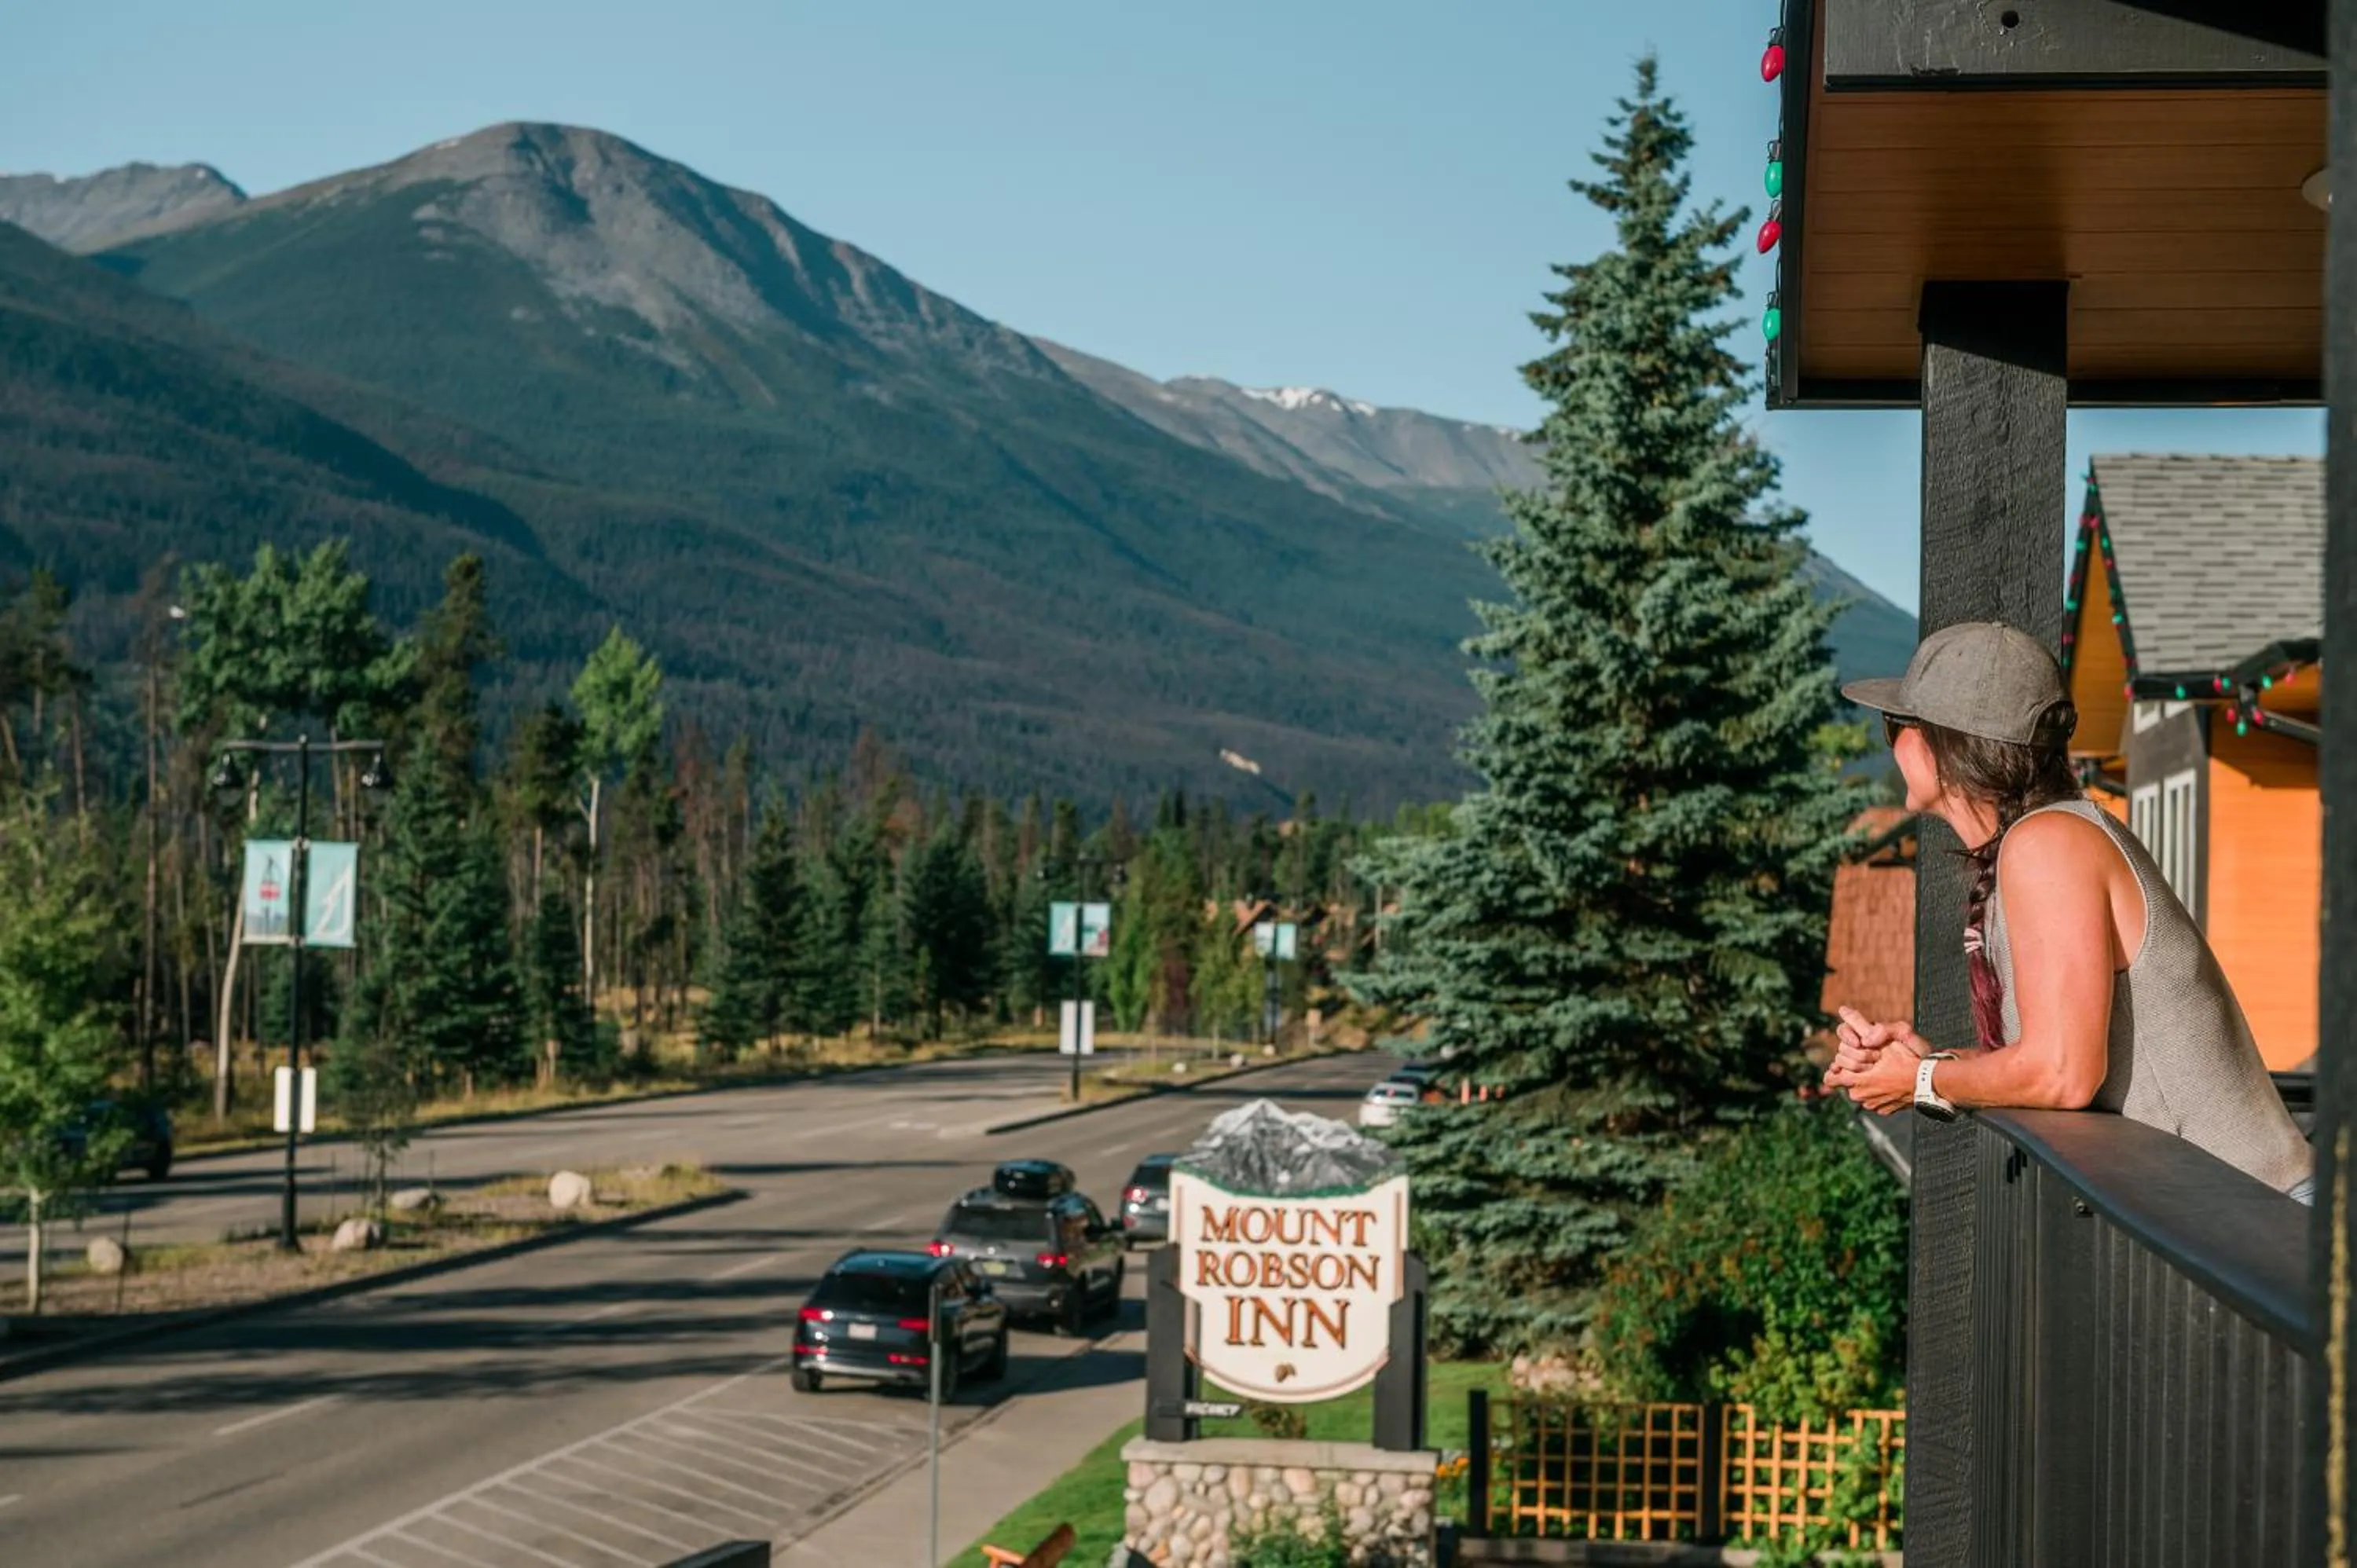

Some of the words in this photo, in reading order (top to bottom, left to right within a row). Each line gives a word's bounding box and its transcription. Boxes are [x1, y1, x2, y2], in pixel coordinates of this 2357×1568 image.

[1200, 1205, 1377, 1247] MOUNT
[1195, 1249, 1380, 1291] ROBSON
[1225, 1295, 1351, 1350] INN
